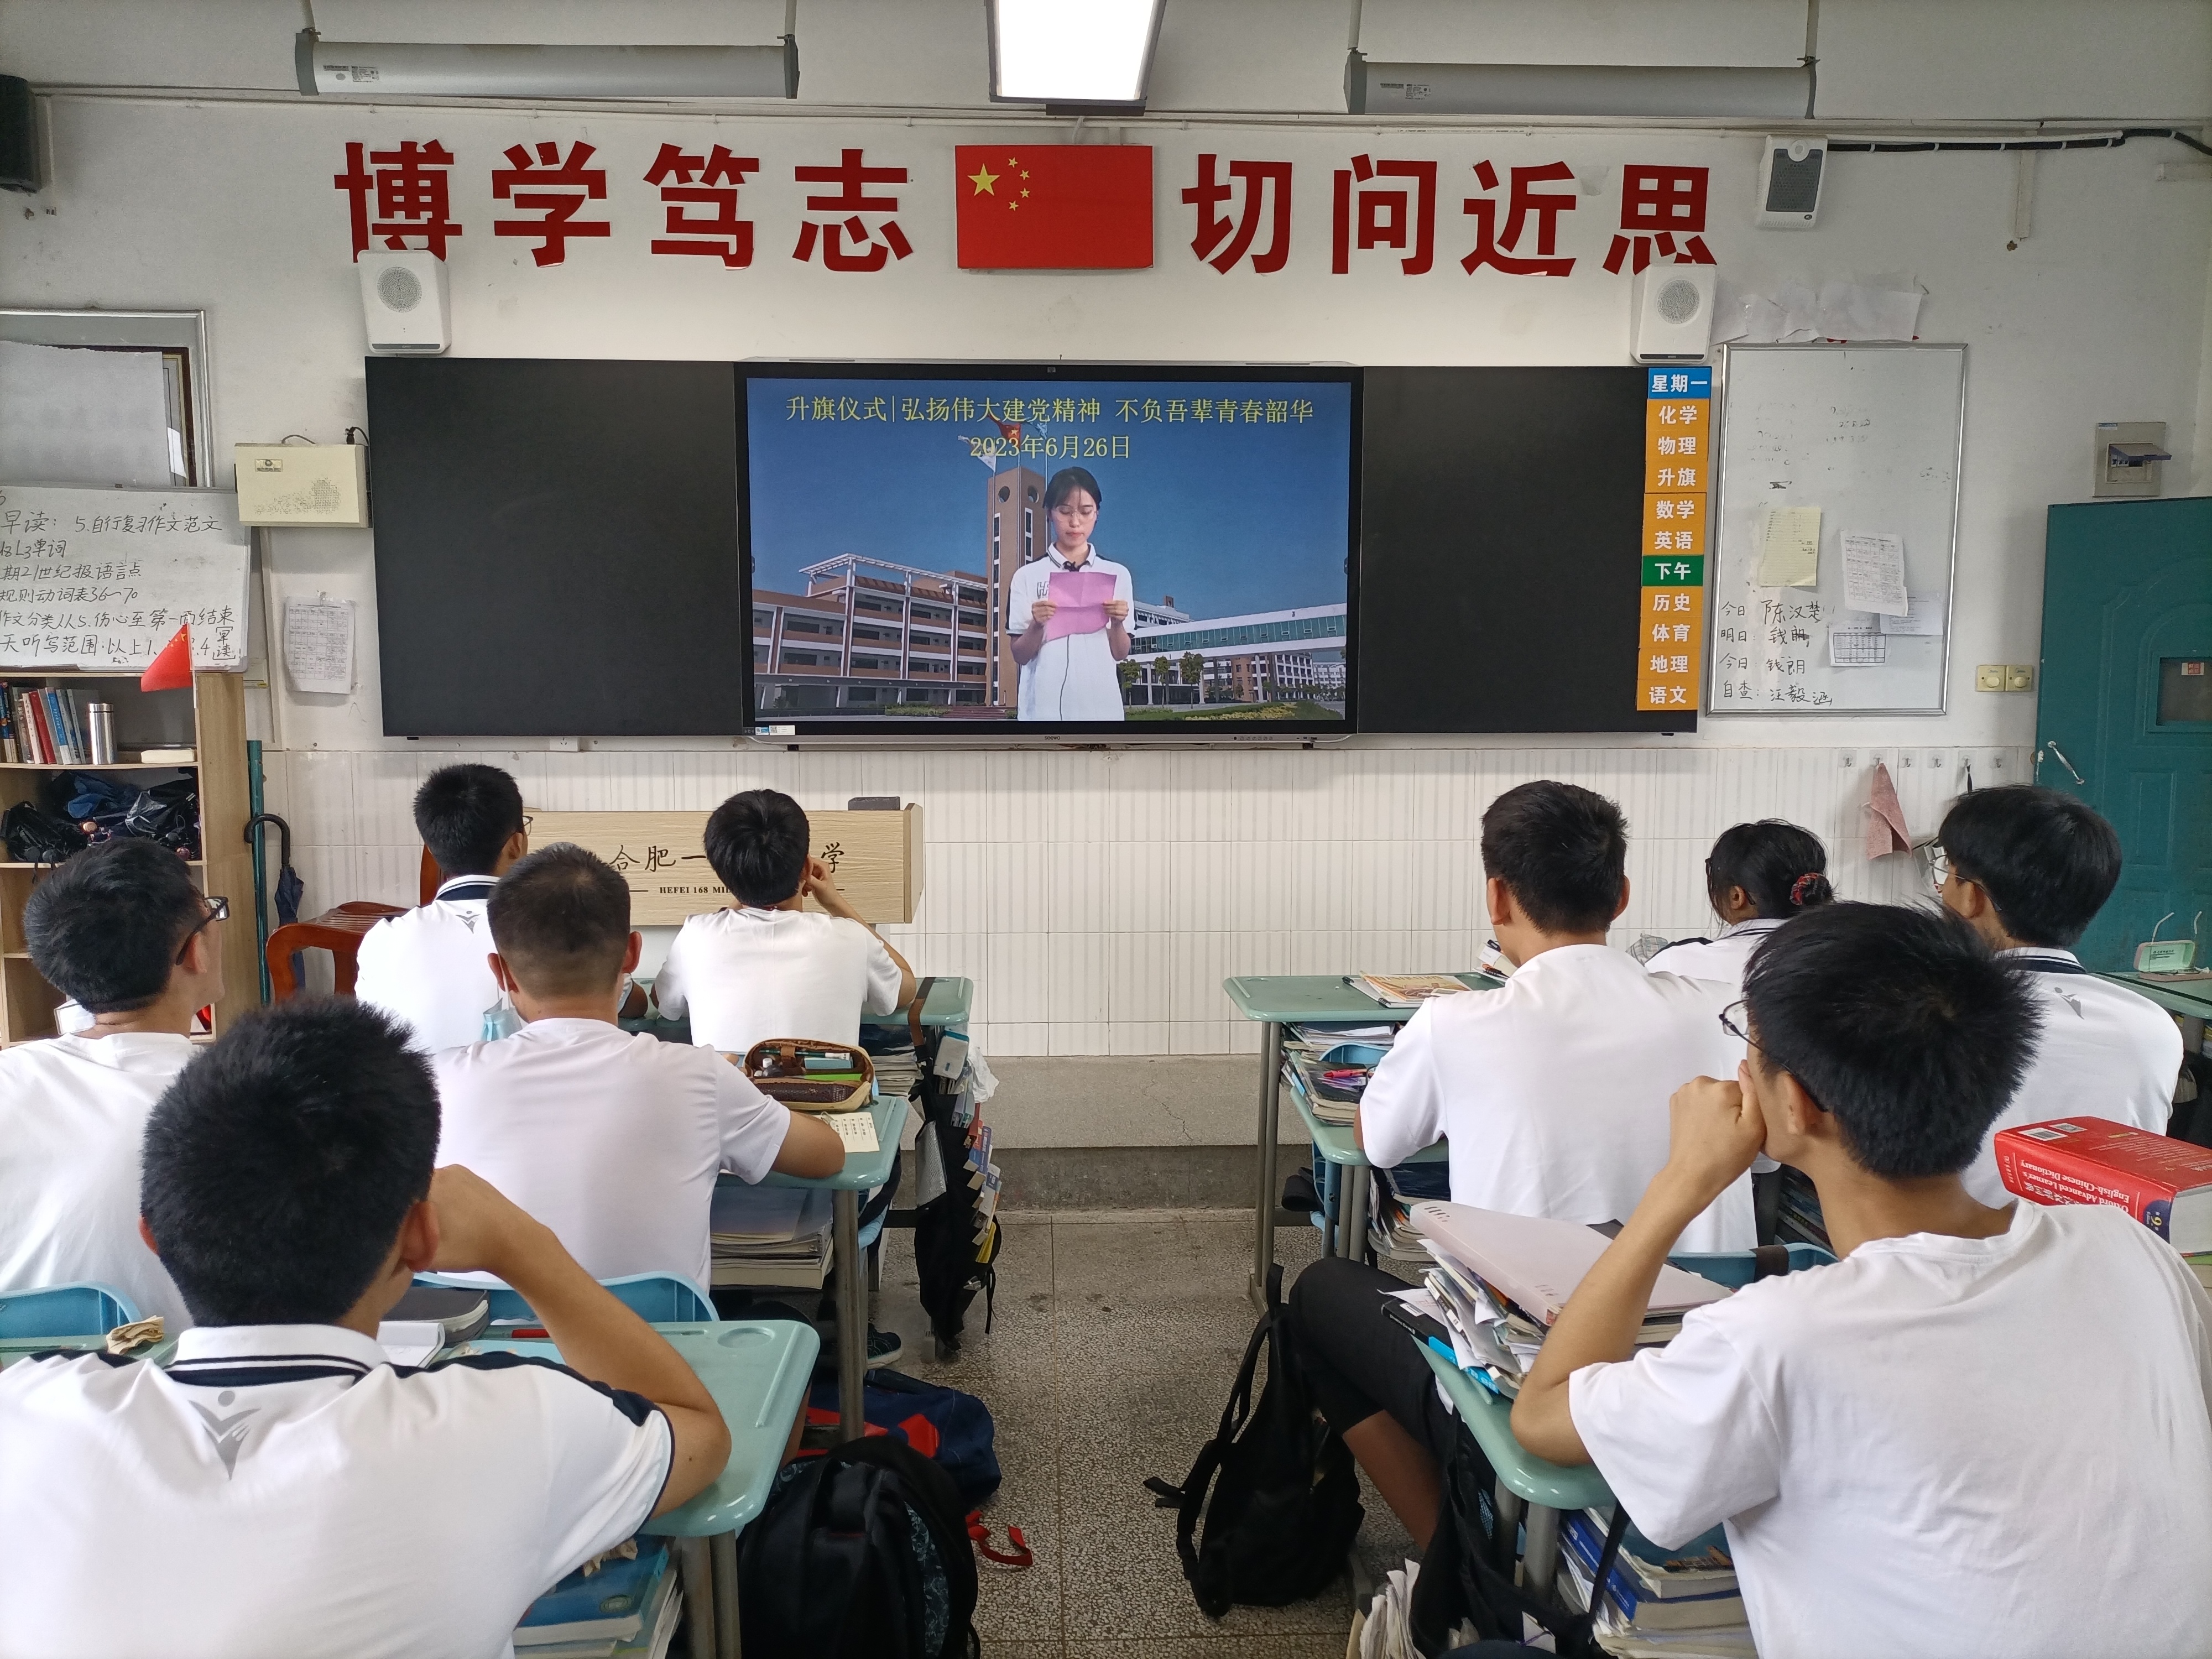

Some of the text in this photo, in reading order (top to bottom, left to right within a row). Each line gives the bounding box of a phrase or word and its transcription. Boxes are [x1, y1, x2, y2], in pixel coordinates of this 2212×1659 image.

[335, 139, 1716, 276] 博学笃志 切问近思
[1651, 374, 1708, 393] 星期一
[1115, 398, 1313, 424] 不负吾辈青春韶华
[1658, 405, 1697, 424] 化学
[970, 435, 1130, 459] 2023年6月26日
[1658, 436, 1697, 455] 物理
[1657, 468, 1696, 487] 升旗
[1656, 500, 1694, 519] 数学
[1655, 530, 1693, 550] 英语
[1655, 562, 1691, 580] 下午
[1652, 593, 1691, 612] 历史
[1652, 623, 1691, 642] 体育
[1650, 655, 1688, 673] 地理
[1648, 685, 1687, 705] 语文
[2021, 1160, 2060, 1181] Dictionary
[2023, 1171, 2057, 1188] Learner's
[2059, 1184, 2098, 1203] Advanced
[2062, 1173, 2130, 1204] English-Chinese
